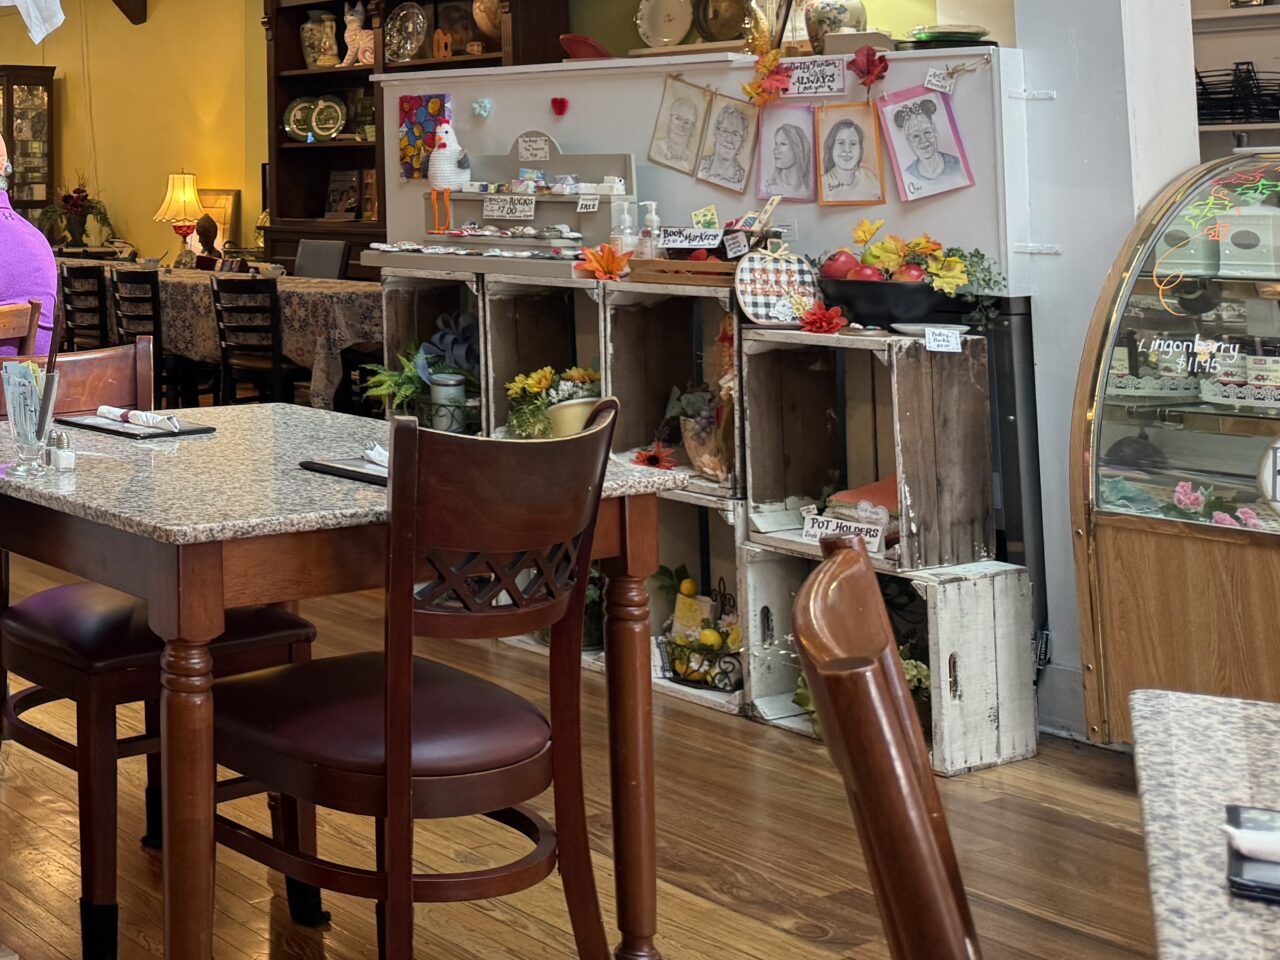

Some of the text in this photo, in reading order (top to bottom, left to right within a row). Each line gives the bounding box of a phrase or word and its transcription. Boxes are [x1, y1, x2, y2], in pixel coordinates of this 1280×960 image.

[794, 73, 835, 85] ALWAYS
[1176, 354, 1221, 373] $11.95
[810, 517, 832, 530] POT
